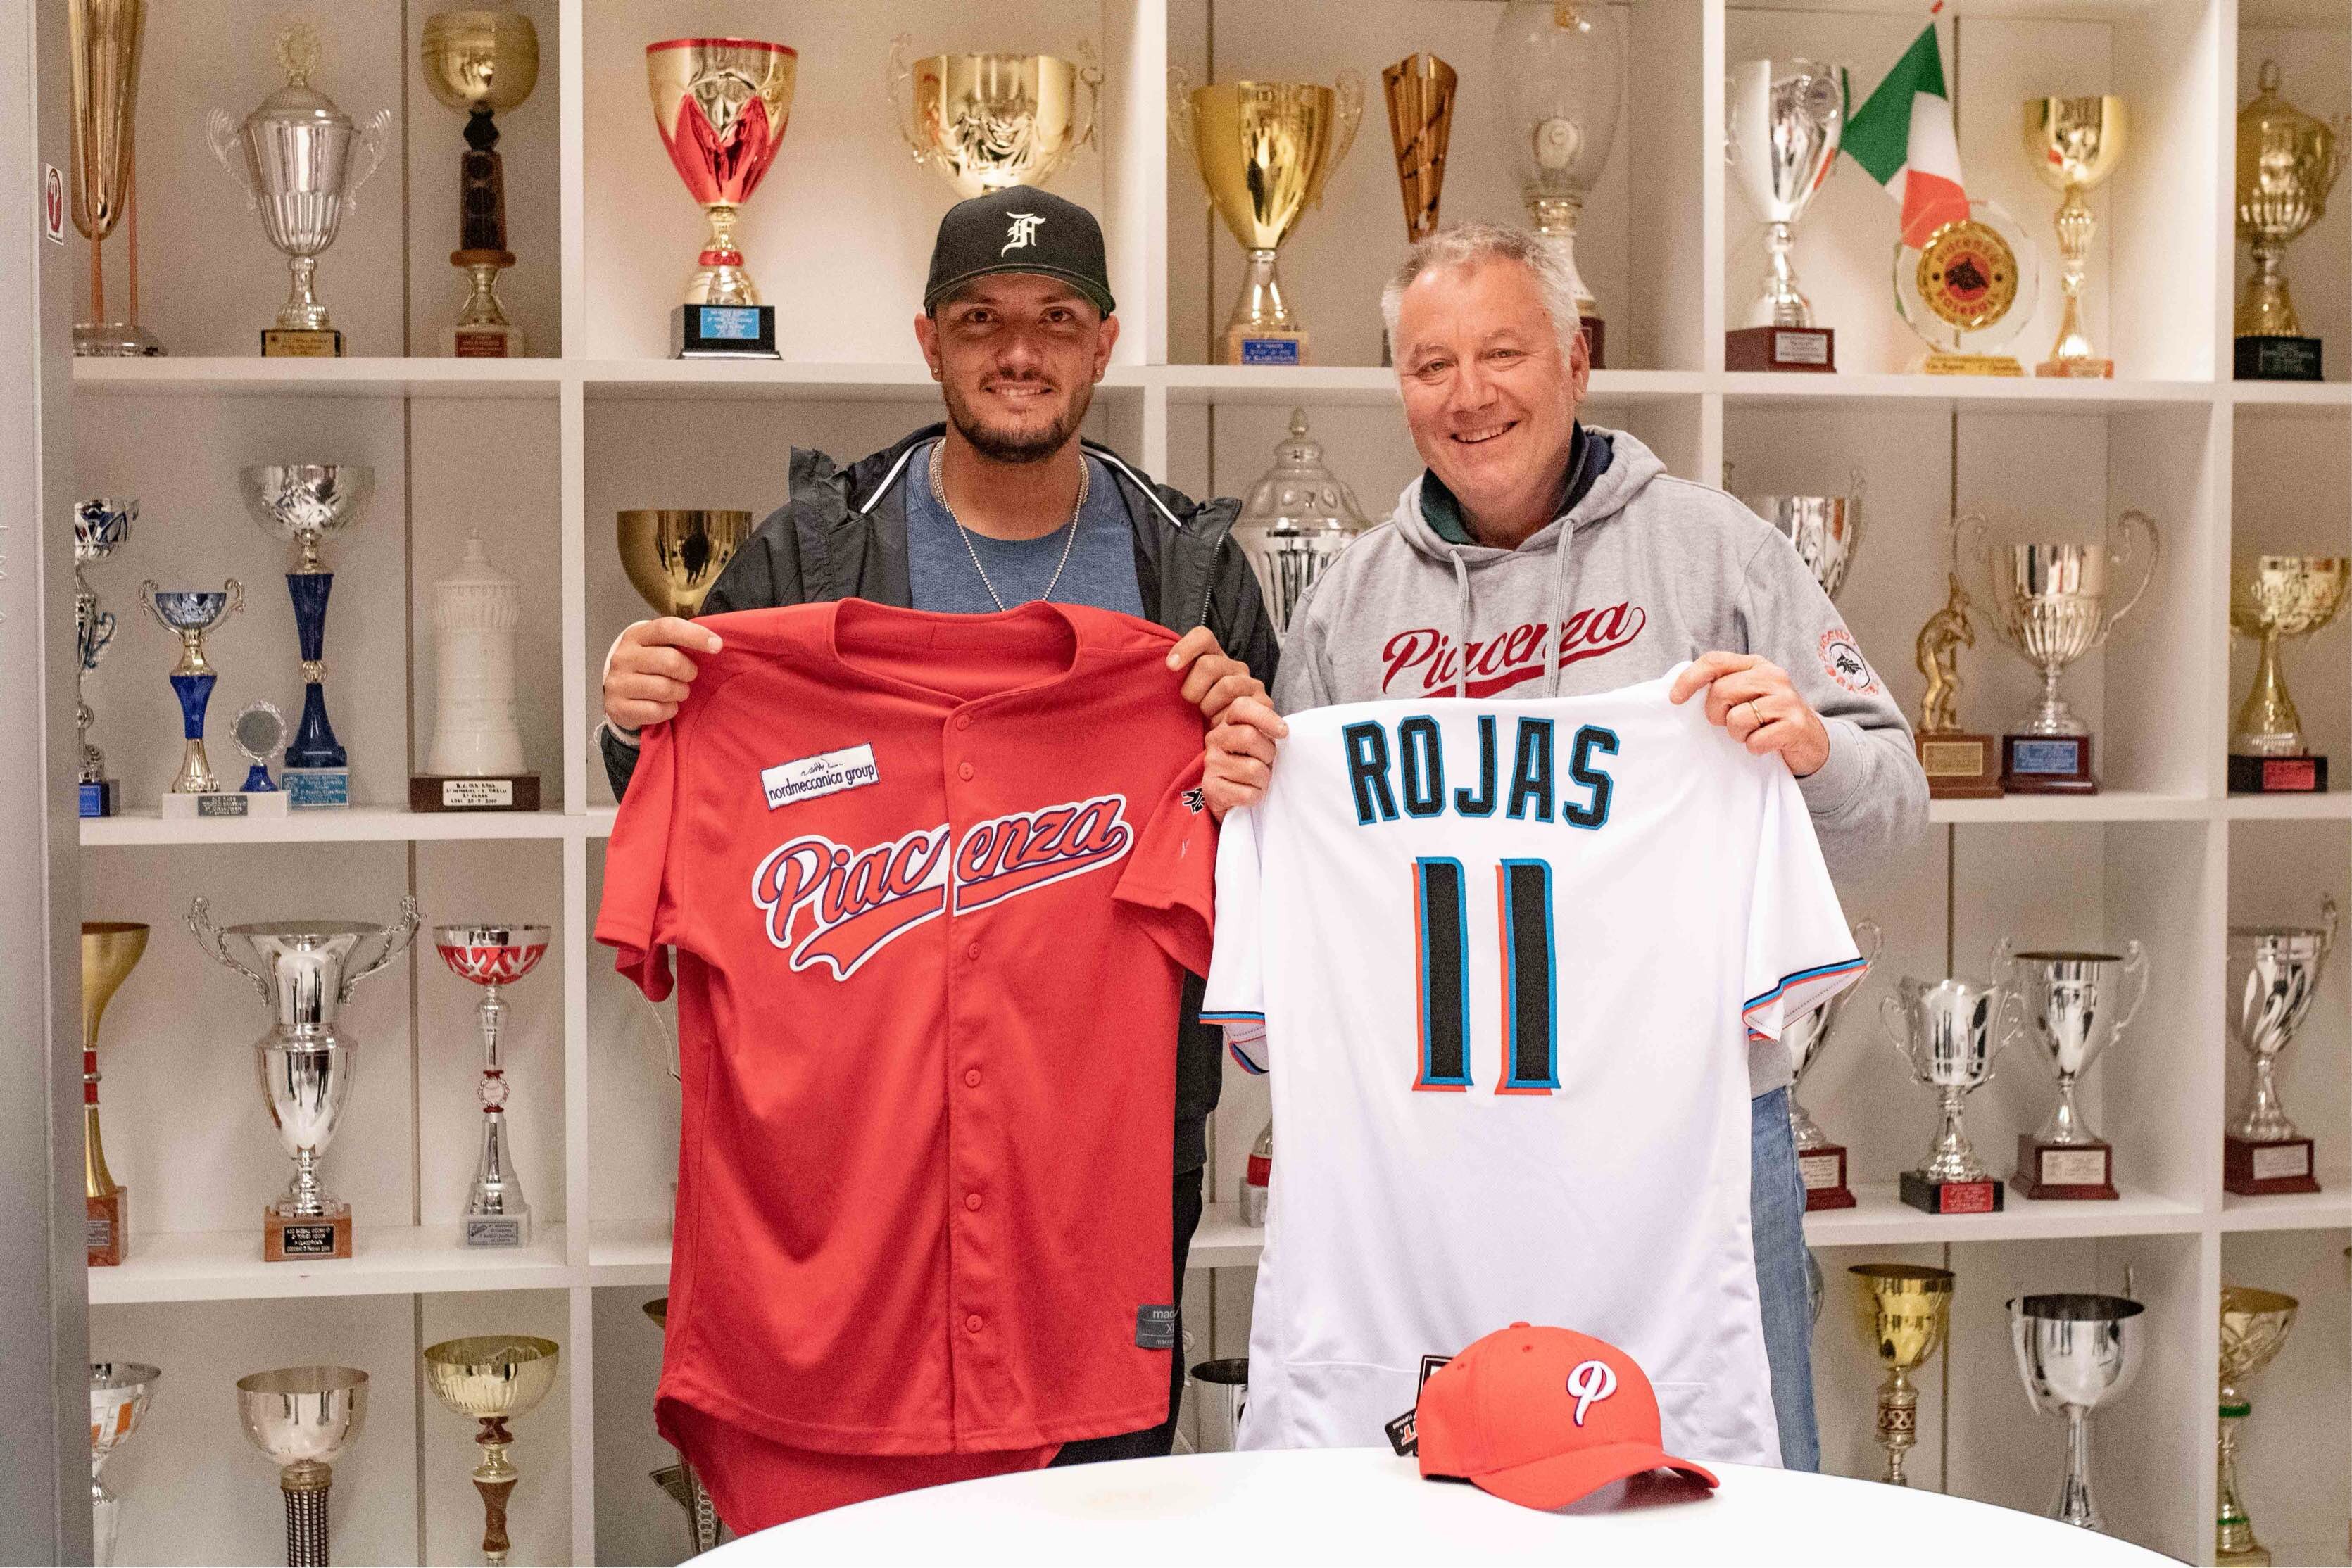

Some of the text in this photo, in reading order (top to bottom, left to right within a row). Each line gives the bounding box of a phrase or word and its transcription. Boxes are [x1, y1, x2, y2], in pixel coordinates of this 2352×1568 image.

[1000, 211, 1047, 258] F
[1382, 600, 1647, 695] Piacenza
[768, 771, 844, 801] nordmeccanica
[845, 764, 875, 785] group
[1340, 712, 1621, 831] ROJAS
[752, 793, 1135, 949] Piacenza
[1412, 856, 1562, 1095] 11
[1566, 1358, 1618, 1427] P
